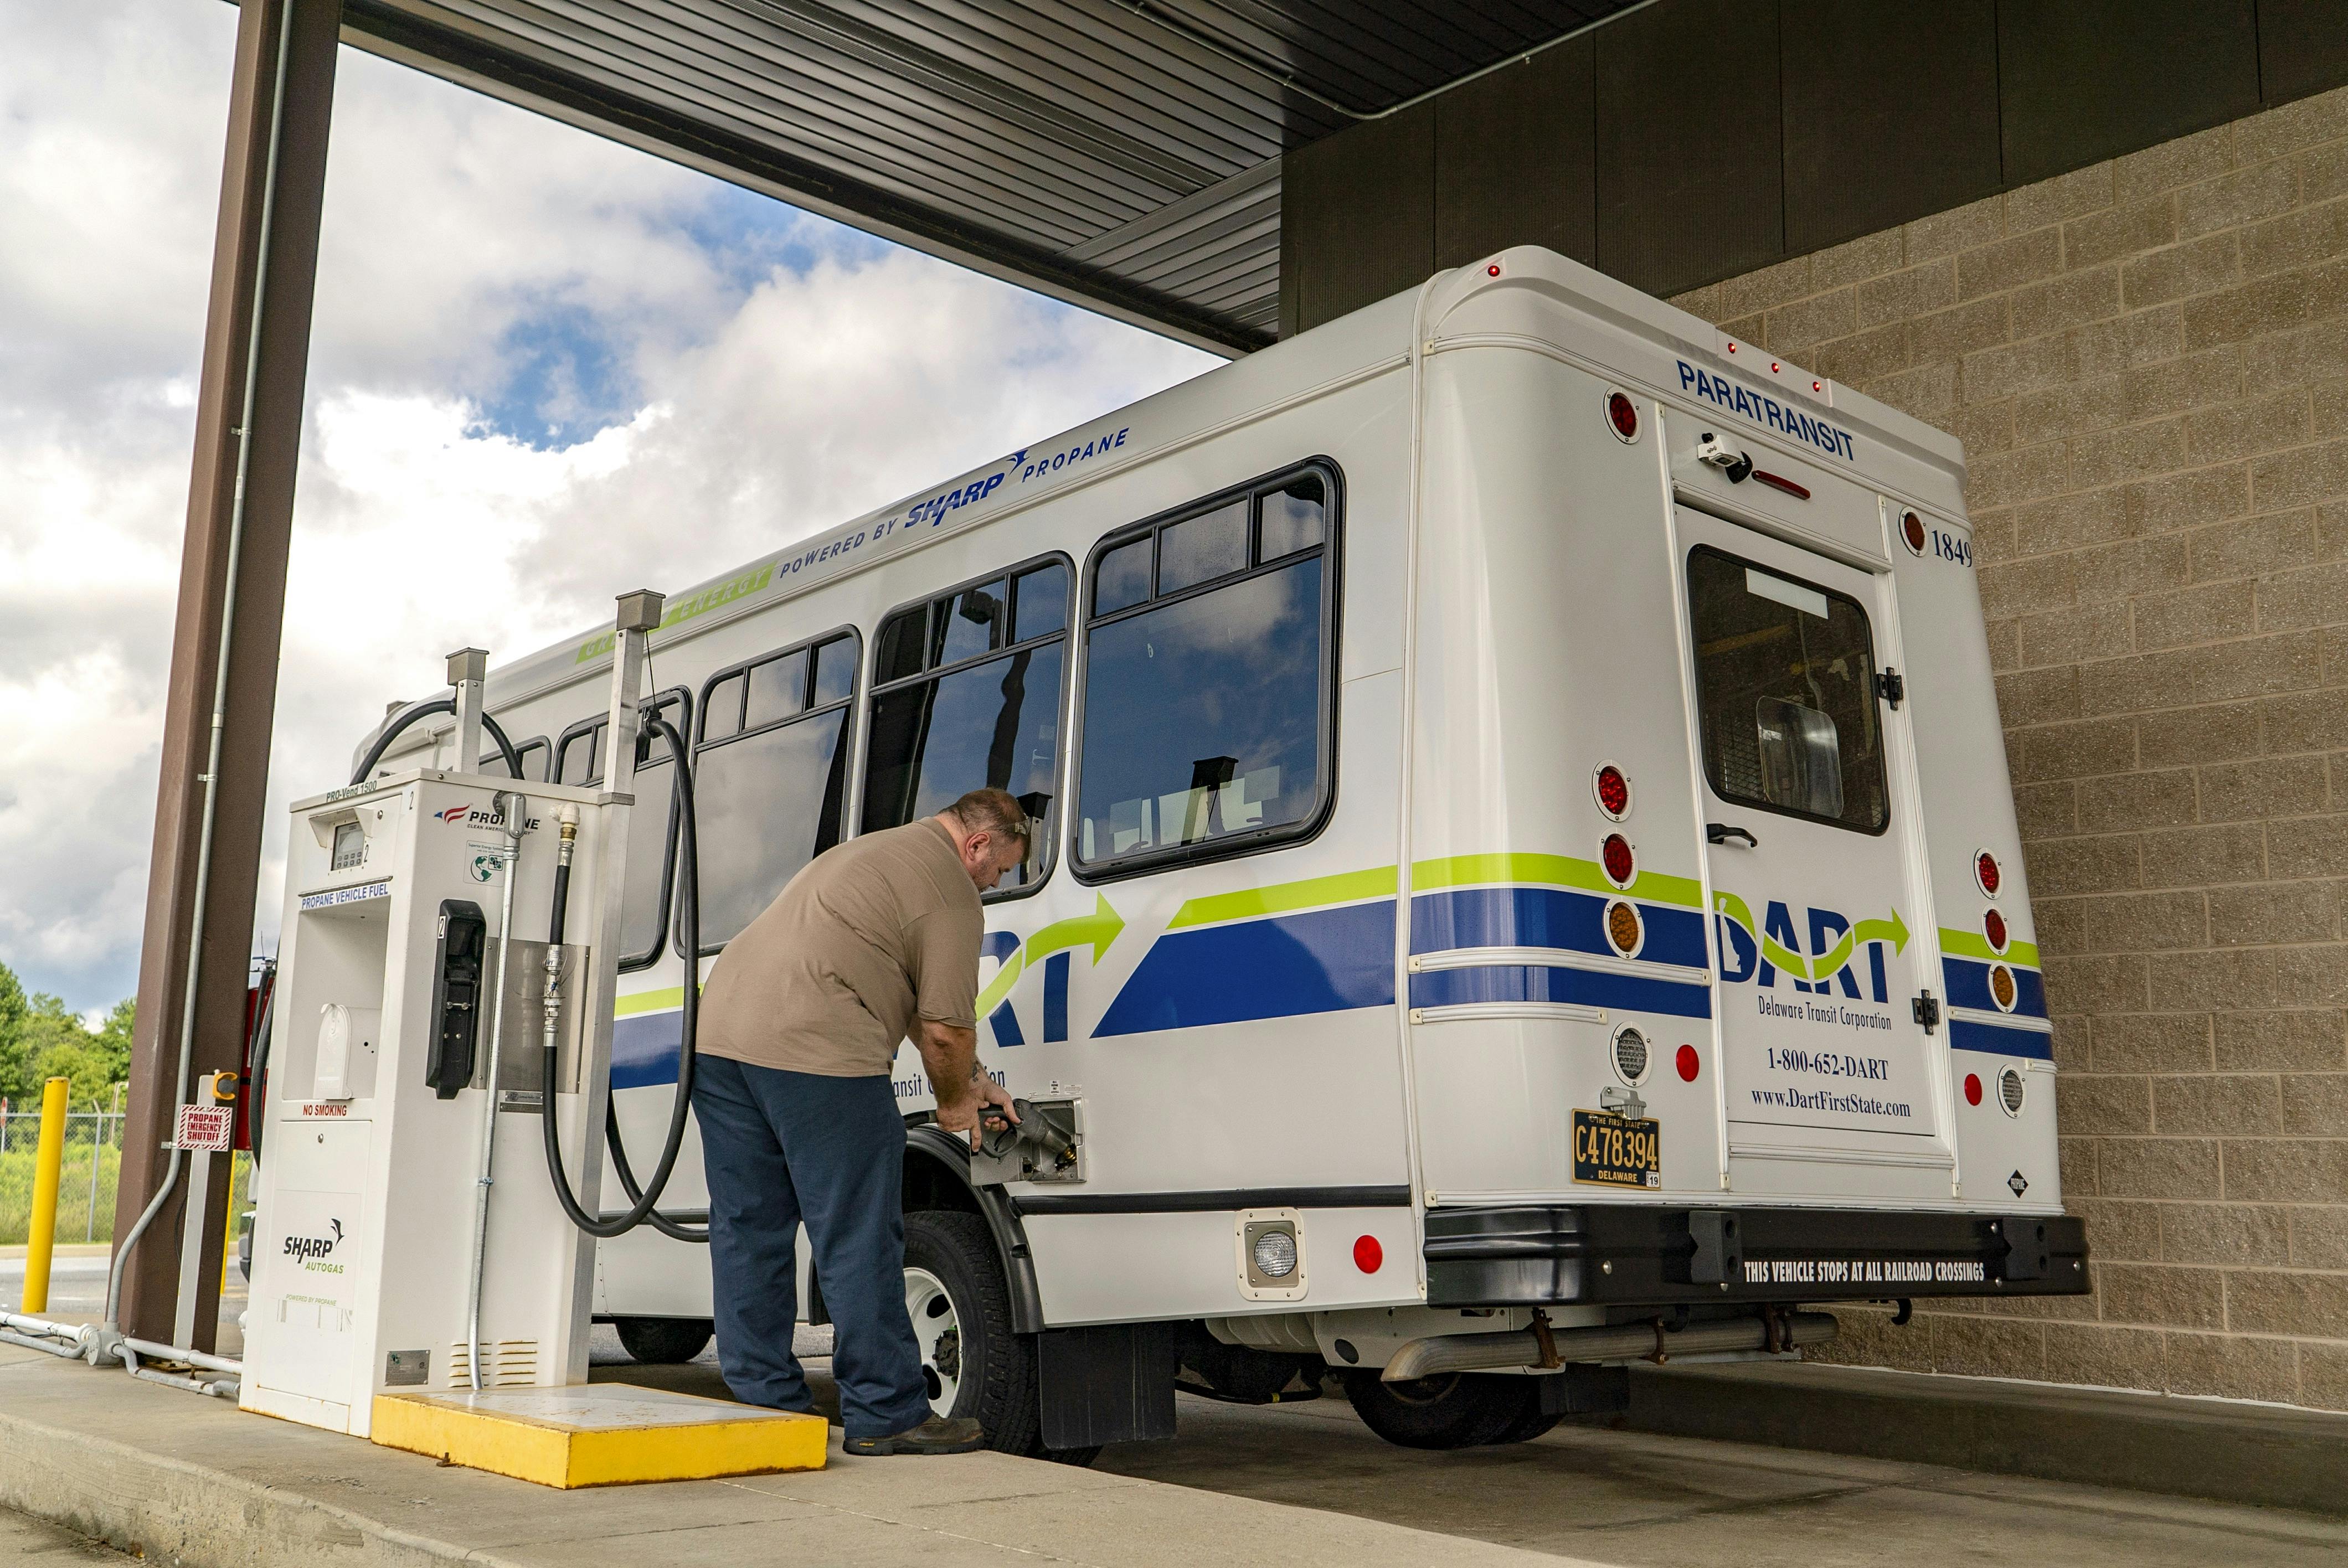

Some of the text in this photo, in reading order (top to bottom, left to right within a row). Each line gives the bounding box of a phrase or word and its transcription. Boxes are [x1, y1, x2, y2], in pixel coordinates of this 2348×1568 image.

[1676, 359, 1854, 461] PARATRANSIT
[680, 569, 767, 618] ENERGY
[780, 532, 866, 579] POWERED
[873, 517, 898, 540] BY
[904, 472, 1005, 527] SHARP
[1022, 427, 1130, 483] PROPANE
[1932, 530, 1973, 568] 1849
[326, 780, 377, 802] PRO-Vend 1500
[409, 791, 414, 810] 2
[469, 811, 540, 829] PRONE
[364, 844, 369, 862] 2
[302, 884, 388, 910] PROPANE VEHICLE FUEL
[439, 918, 444, 937] 2
[1713, 890, 1910, 1004] DART
[1758, 995, 1892, 1031] Delaware Transit Corporation
[1767, 1047, 1888, 1080] 1-800-652-DART
[893, 1073, 922, 1098] ansit
[303, 1105, 347, 1116] NO SMOKING
[1752, 1088, 1911, 1117] www.DartFirstState.com
[187, 1122, 222, 1132] EMERGENCY
[188, 1113, 223, 1123] PROPANE
[1609, 1118, 1622, 1126] FIRST
[187, 1131, 220, 1141] SHUTOFF
[1576, 1125, 1657, 1170] C478394
[1598, 1170, 1638, 1182] DELAWARE
[1650, 1176, 1659, 1185] 19
[284, 1236, 332, 1263] SHARP
[305, 1262, 344, 1273] AUTOGAS
[1744, 1261, 1984, 1282] THIS VEHICLE STOPS AT ALL RAILROAD CROSSINGS
[286, 1294, 308, 1302] POWERED
[315, 1298, 337, 1306] PROPANE
